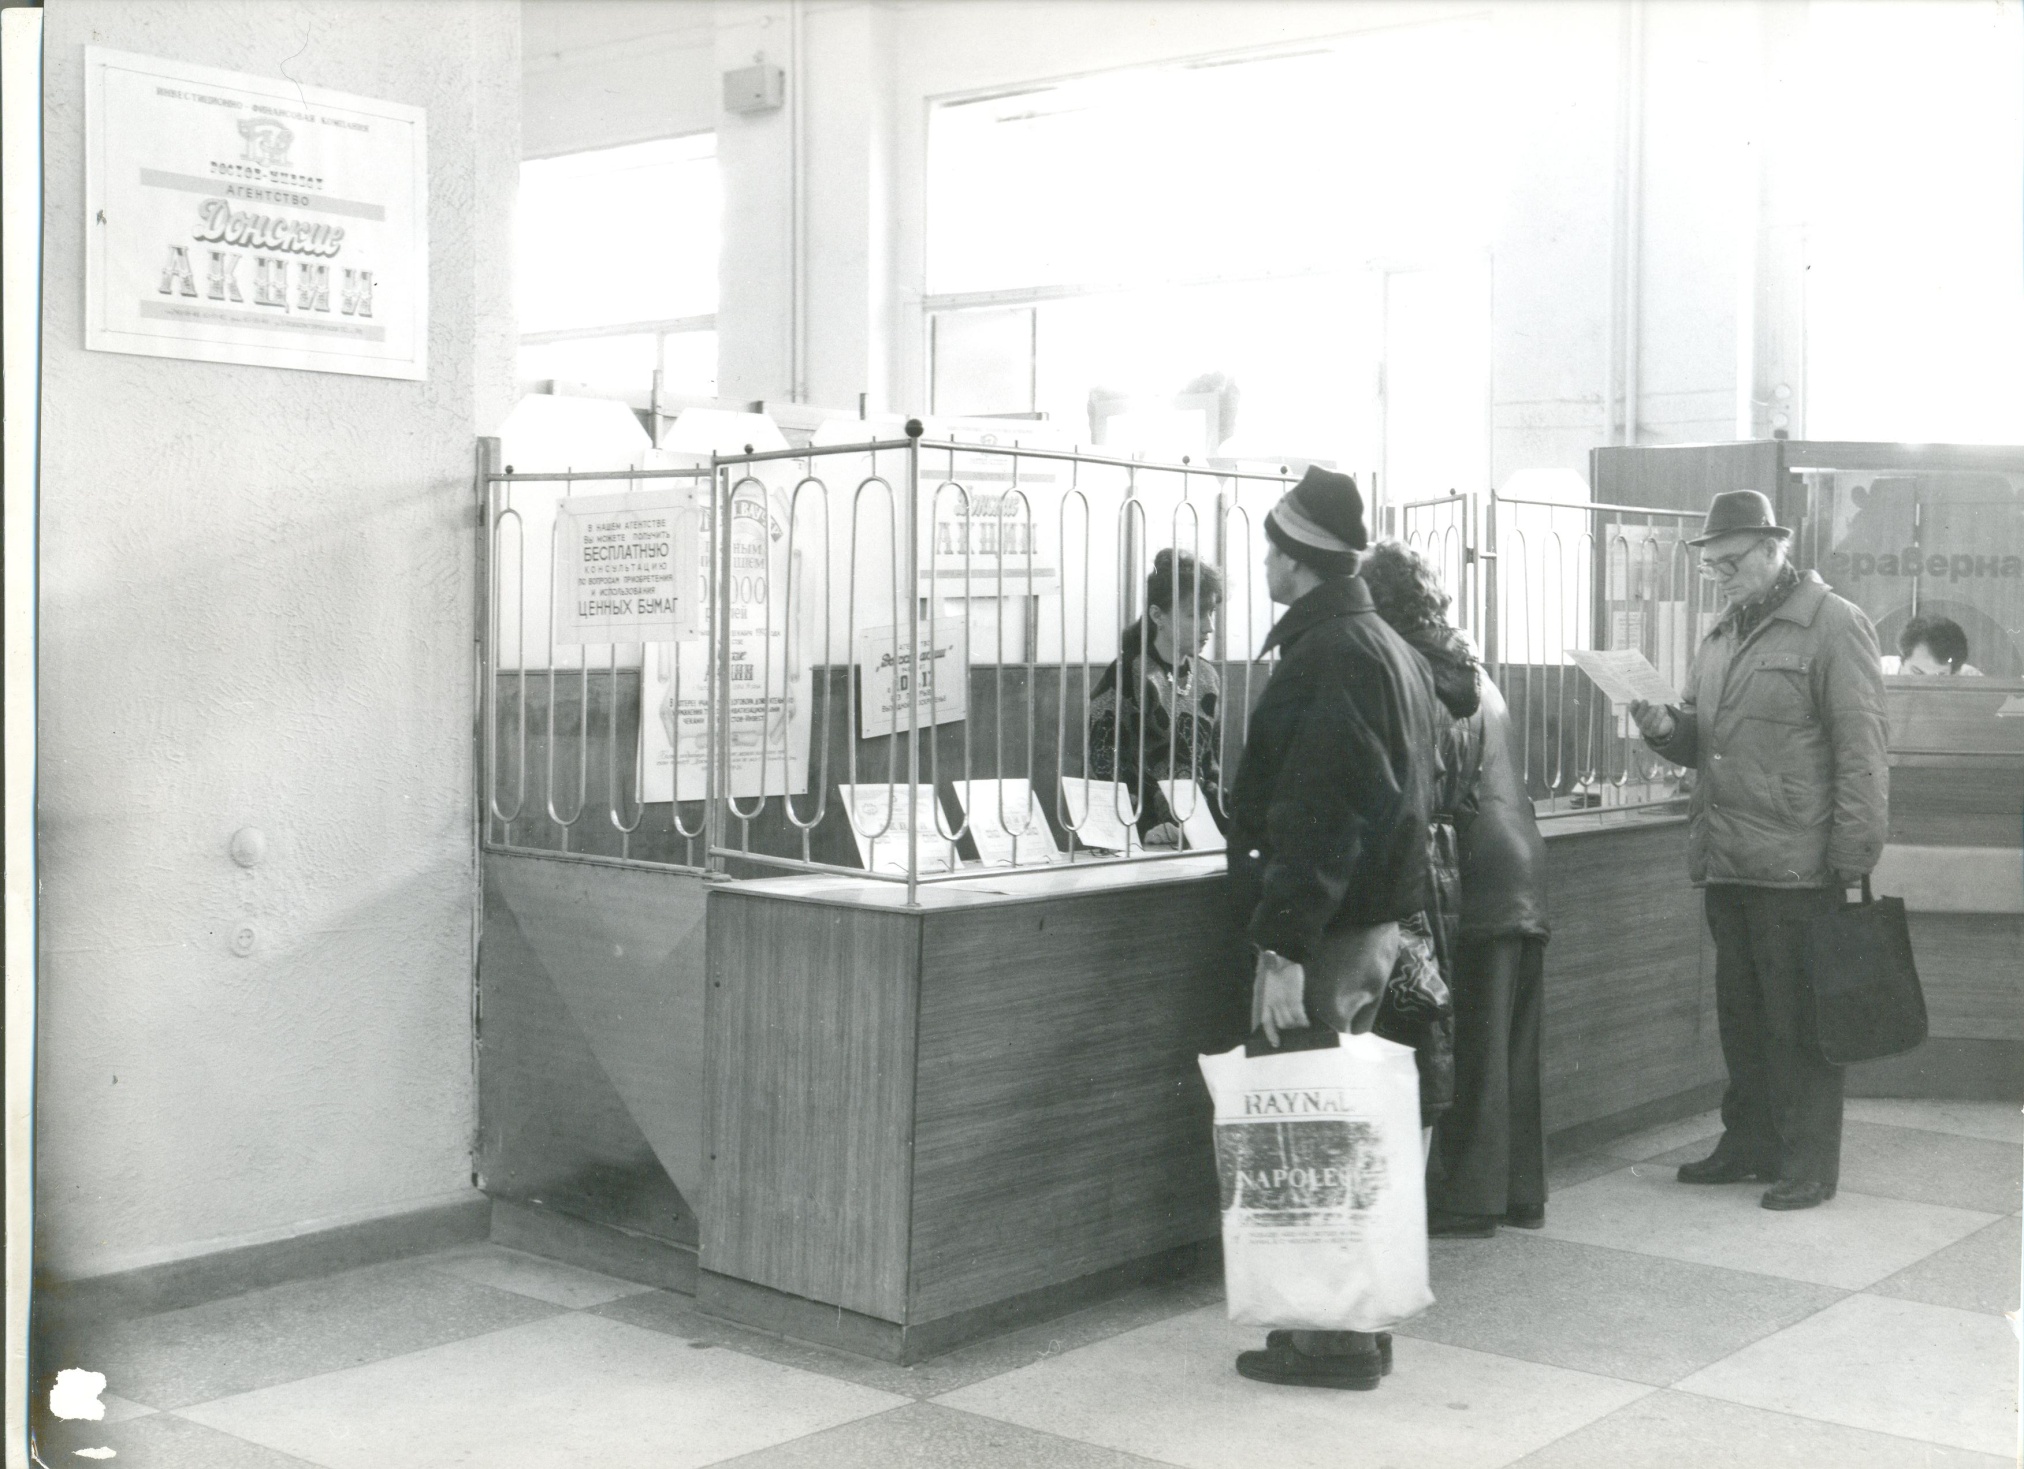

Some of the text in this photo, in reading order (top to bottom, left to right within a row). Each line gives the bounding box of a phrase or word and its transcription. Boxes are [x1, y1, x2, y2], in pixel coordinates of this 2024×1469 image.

[226, 185, 309, 206] АГЕНТСТВО
[192, 197, 345, 258] Донские
[158, 243, 373, 318] АКЦИИ
[596, 522, 621, 532] НАШЕМ
[624, 518, 666, 529] АГЕНТСТВЕ
[596, 533, 625, 543] МОЖЕТЕ
[583, 542, 669, 562] БЕСПЛАТНУЮ
[584, 562, 667, 574] КОНСУЛЬТАЦИЮ
[588, 576, 620, 586] ВОПРОСАМ
[623, 573, 673, 583] ПРИОБРЕТЕНИЯ
[599, 586, 656, 597] ИСПОЛЬЗОВАНИЯ
[578, 597, 679, 619] ЦЕННЫХ БУМАГ
